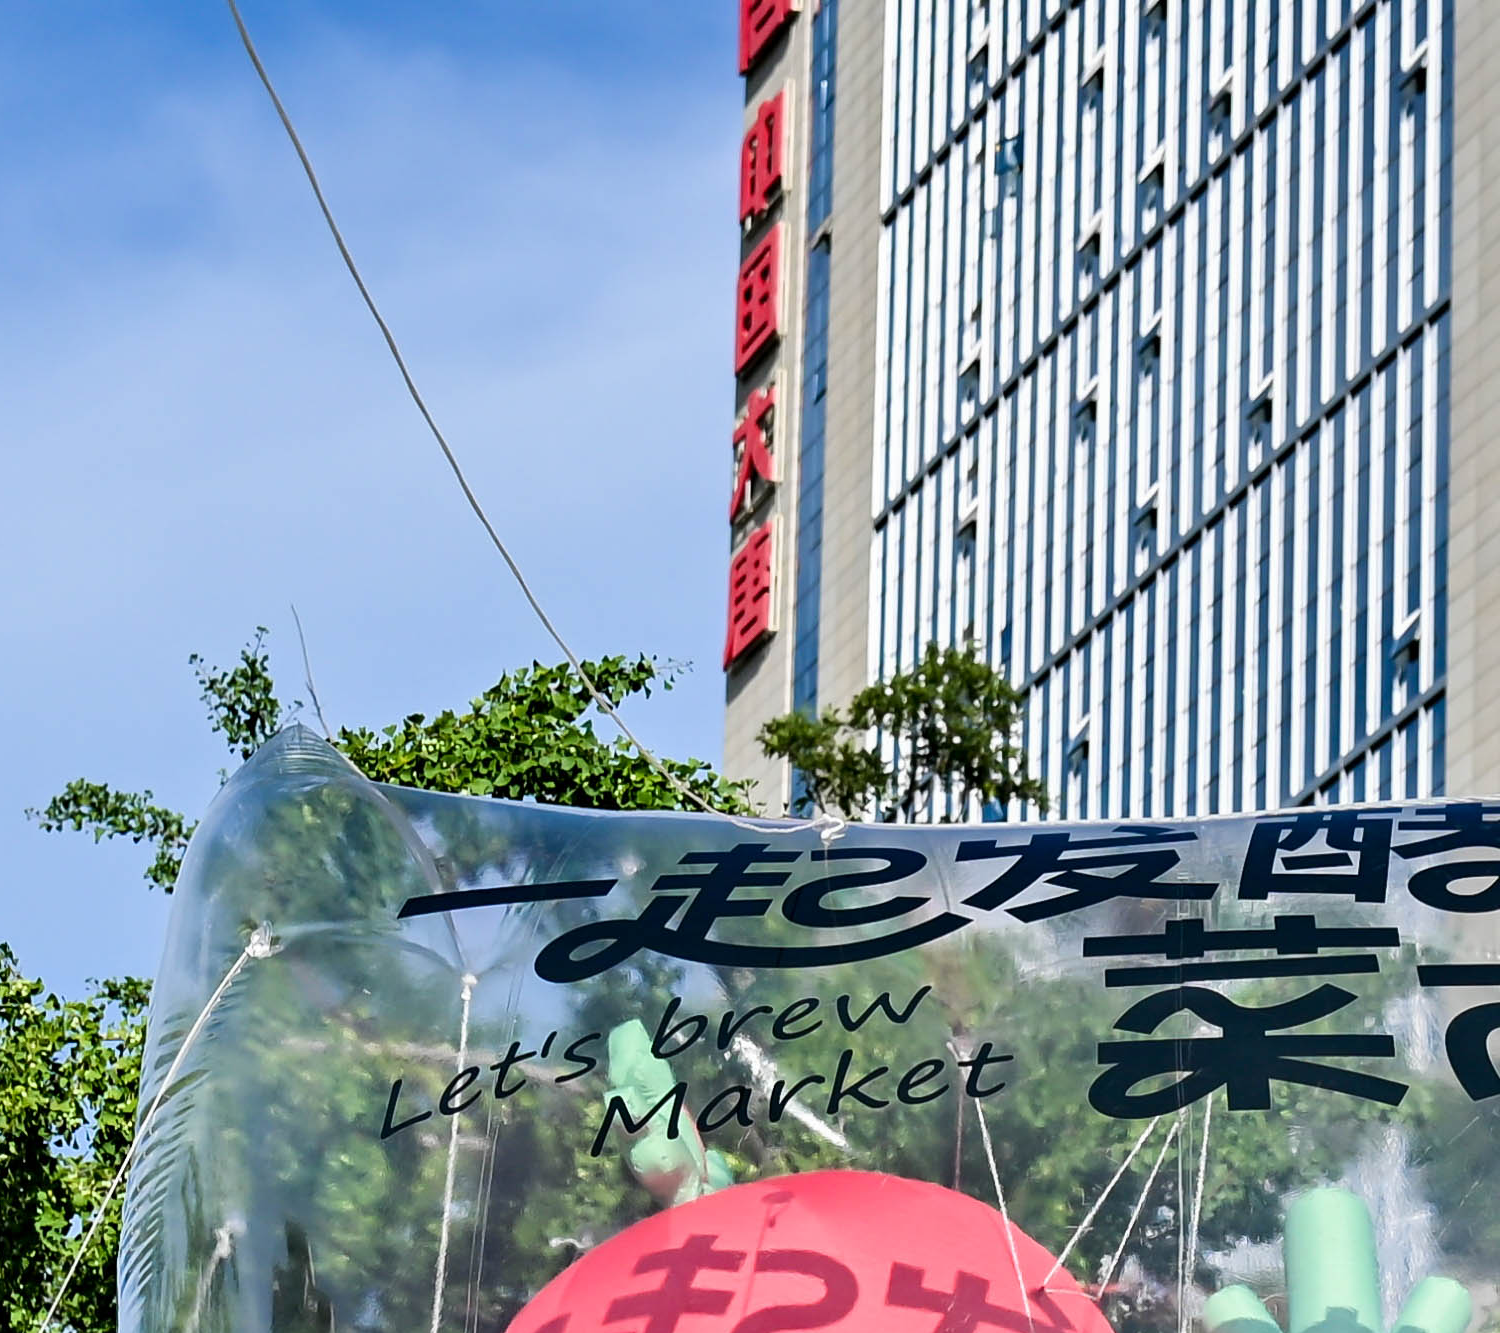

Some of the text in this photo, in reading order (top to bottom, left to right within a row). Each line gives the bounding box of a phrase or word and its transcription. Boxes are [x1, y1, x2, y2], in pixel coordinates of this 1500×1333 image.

[380, 985, 933, 1142] Let's brew
[590, 1041, 1013, 1158] Market
